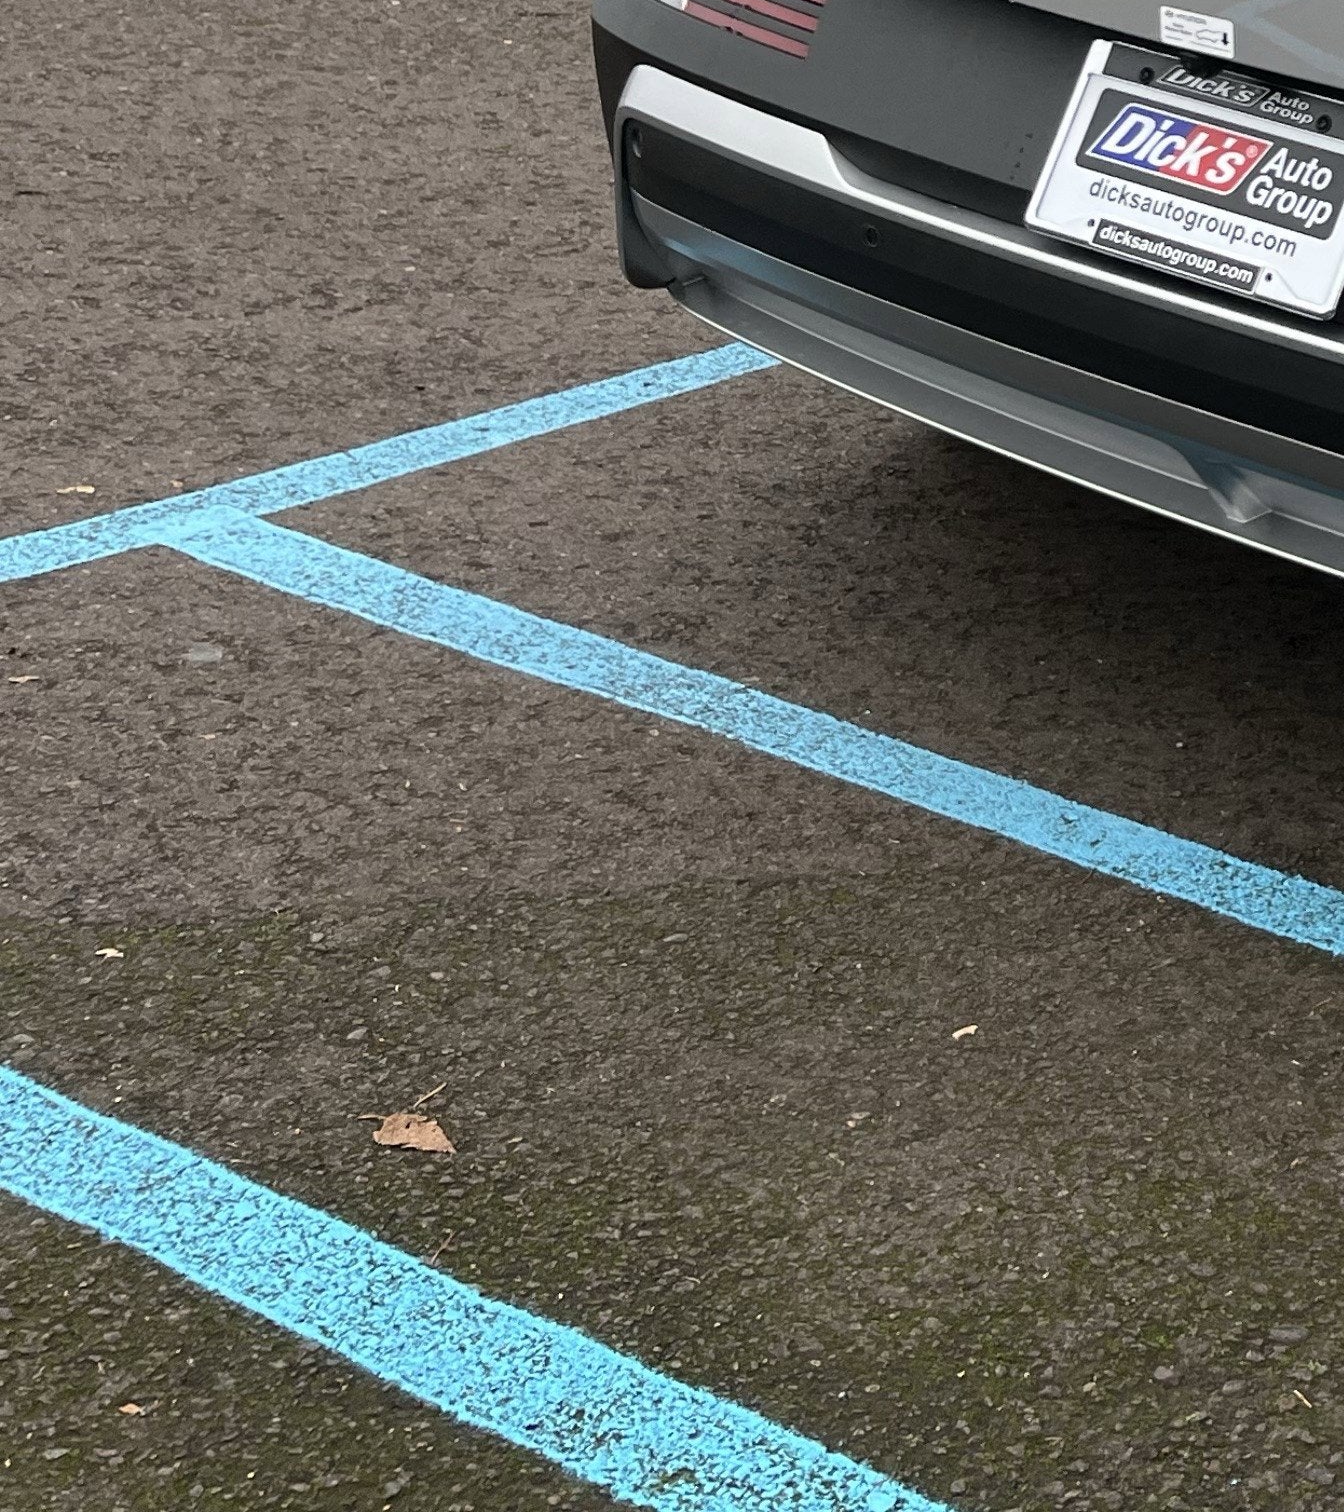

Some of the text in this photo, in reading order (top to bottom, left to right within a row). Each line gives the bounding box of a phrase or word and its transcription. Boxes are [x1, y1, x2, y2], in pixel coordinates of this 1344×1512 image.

[1259, 100, 1314, 125] Group
[1268, 91, 1311, 112] Auto
[1100, 112, 1246, 185] Dick's
[1259, 147, 1333, 191] Auto
[1089, 178, 1297, 258] dicksautogroup.com
[1245, 173, 1333, 229] Group
[1099, 224, 1254, 284] dicksautogroup.com
